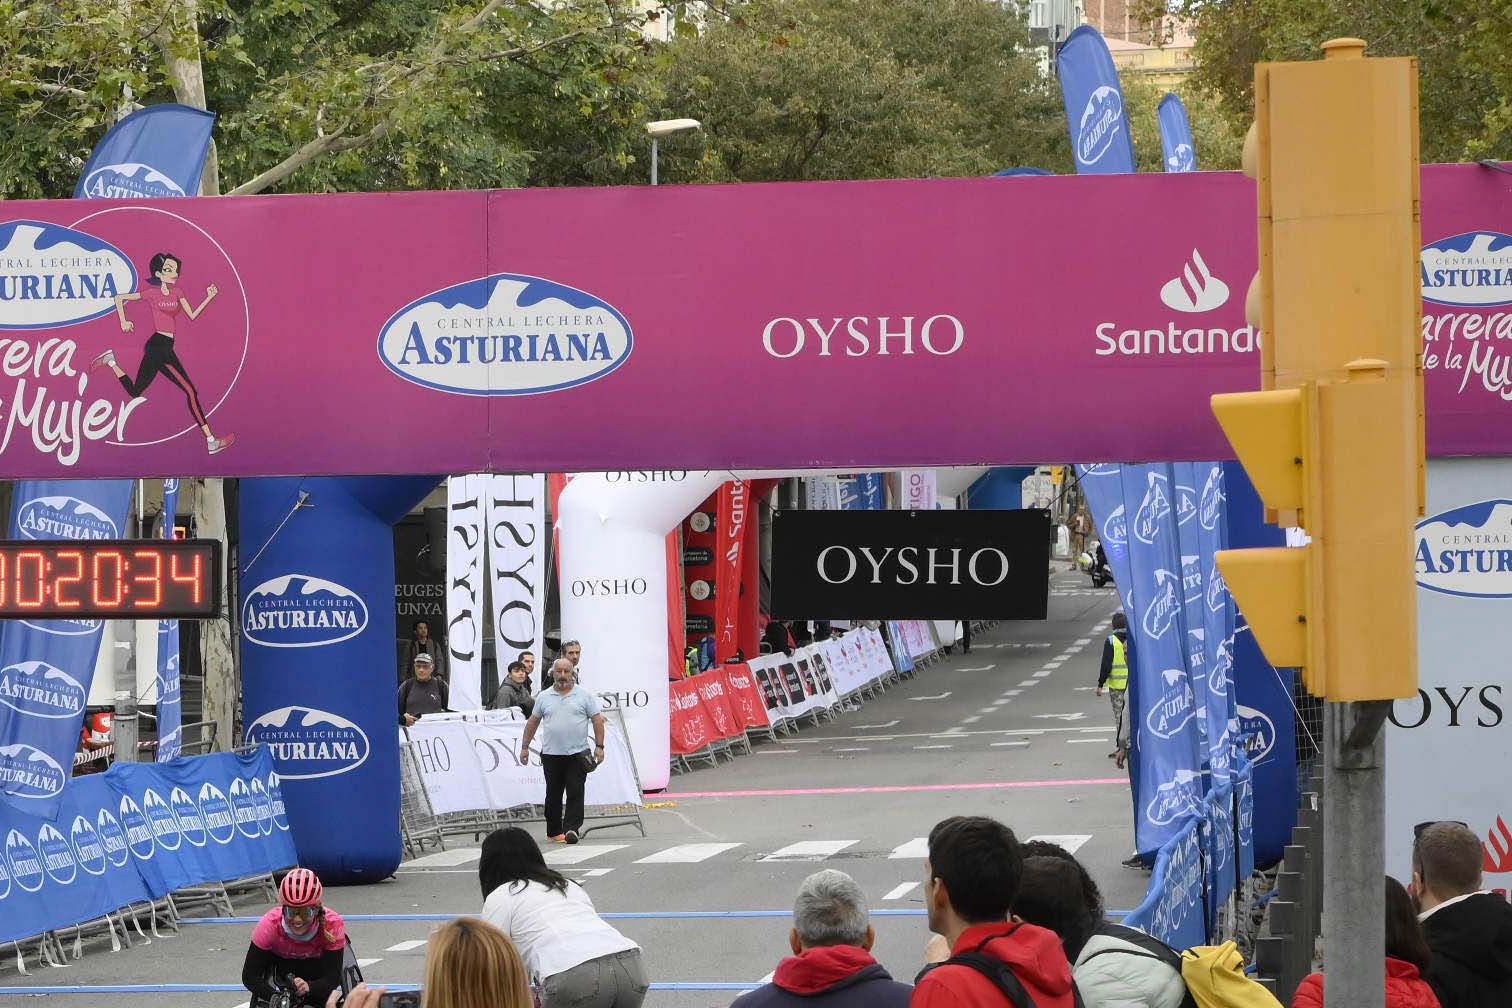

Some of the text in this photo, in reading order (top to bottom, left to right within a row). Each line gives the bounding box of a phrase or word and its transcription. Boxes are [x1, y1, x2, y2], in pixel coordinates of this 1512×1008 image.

[40, 257, 112, 268] LECHERA
[1436, 257, 1486, 266] CENTRAL
[437, 315, 605, 330] CENTRAL LECHERA
[1421, 312, 1512, 342] arrera
[398, 320, 613, 366] ASTURIANA
[762, 314, 964, 359] OYSHO
[1444, 341, 1463, 369] la
[24, 508, 110, 540] ASTURIANA
[1442, 534, 1509, 545] CENTRAL
[816, 545, 1009, 586] OYSHO
[395, 584, 444, 597] EUGES
[572, 577, 647, 597] OYSHO
[259, 599, 354, 608] CENTRAL LECHERA
[396, 602, 443, 615] UNYA
[246, 603, 358, 631] ASTURIANA
[602, 690, 649, 709] SHO
[261, 731, 301, 739] CENTRAL
[268, 742, 360, 760] TURIANA
